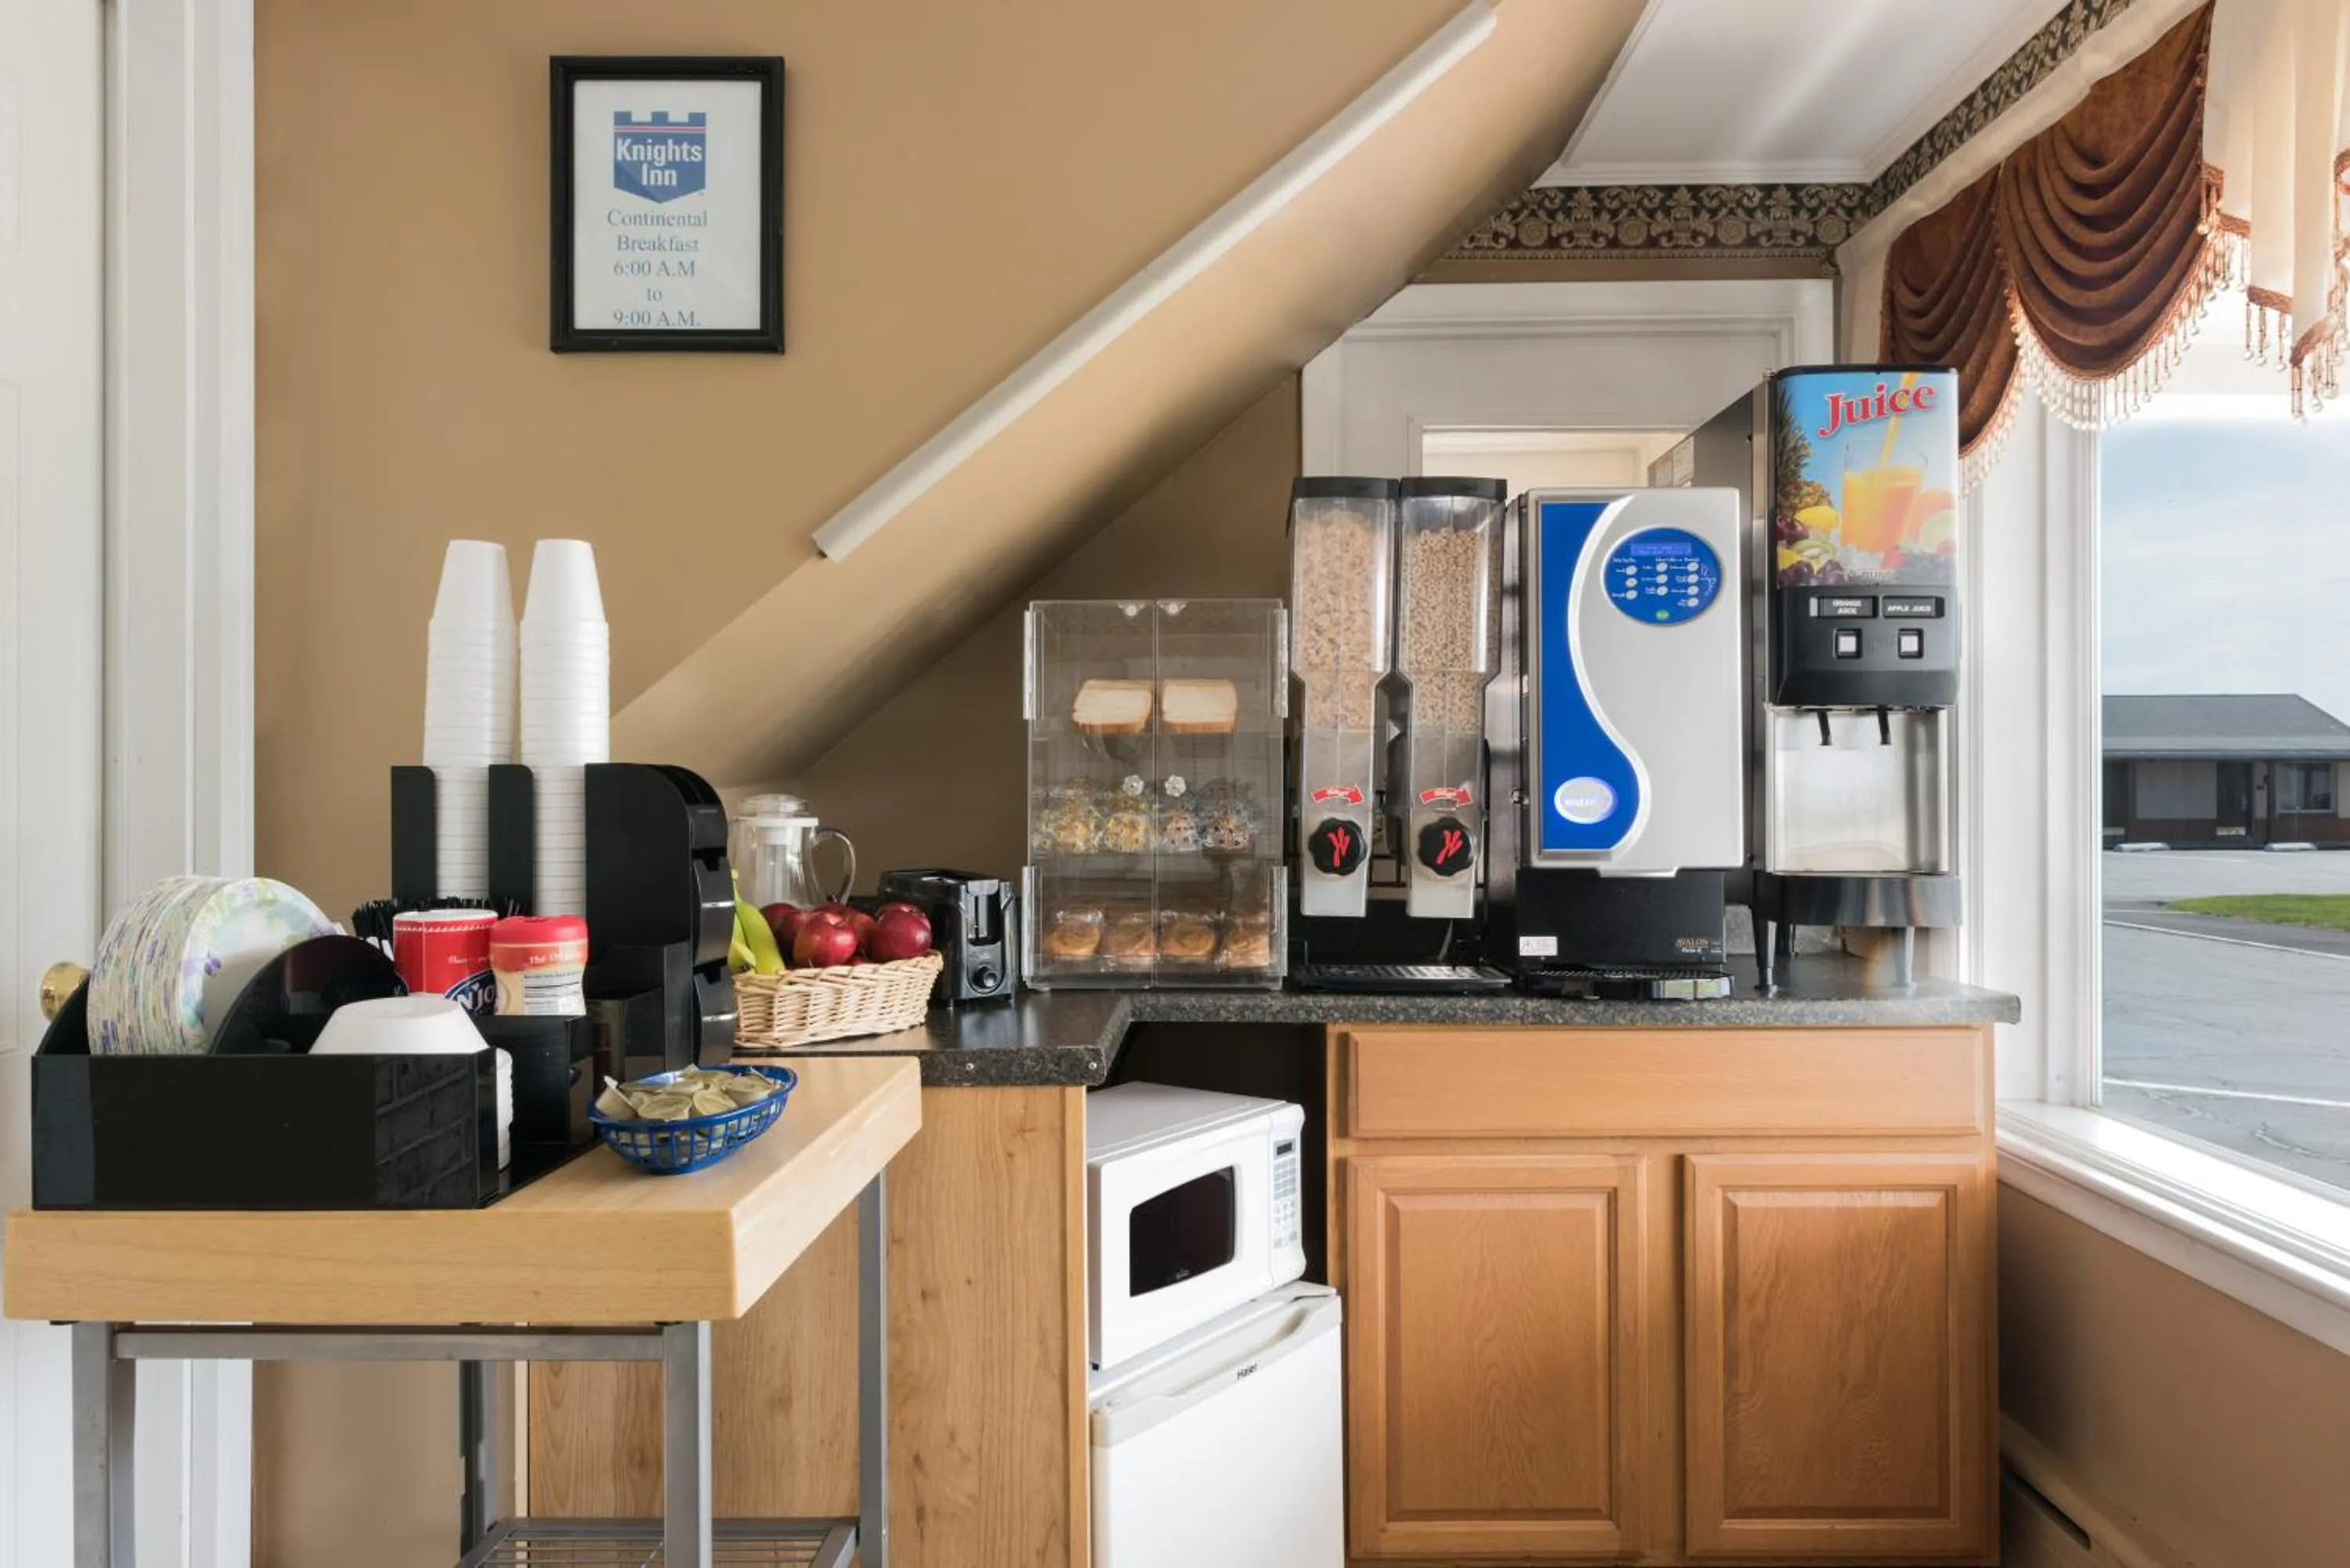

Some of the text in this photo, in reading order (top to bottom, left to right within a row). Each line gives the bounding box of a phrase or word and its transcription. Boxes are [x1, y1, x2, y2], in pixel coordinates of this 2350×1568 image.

[616, 138, 703, 167] Knights
[641, 163, 678, 186] Inn
[607, 208, 707, 226] Continental
[617, 233, 699, 251] Breakfast
[613, 259, 651, 276] 6:00
[647, 287, 663, 302] to
[613, 309, 701, 327] 9:00 A.M.
[1817, 381, 1938, 438] Juice
[457, 981, 495, 1010] N'JO
